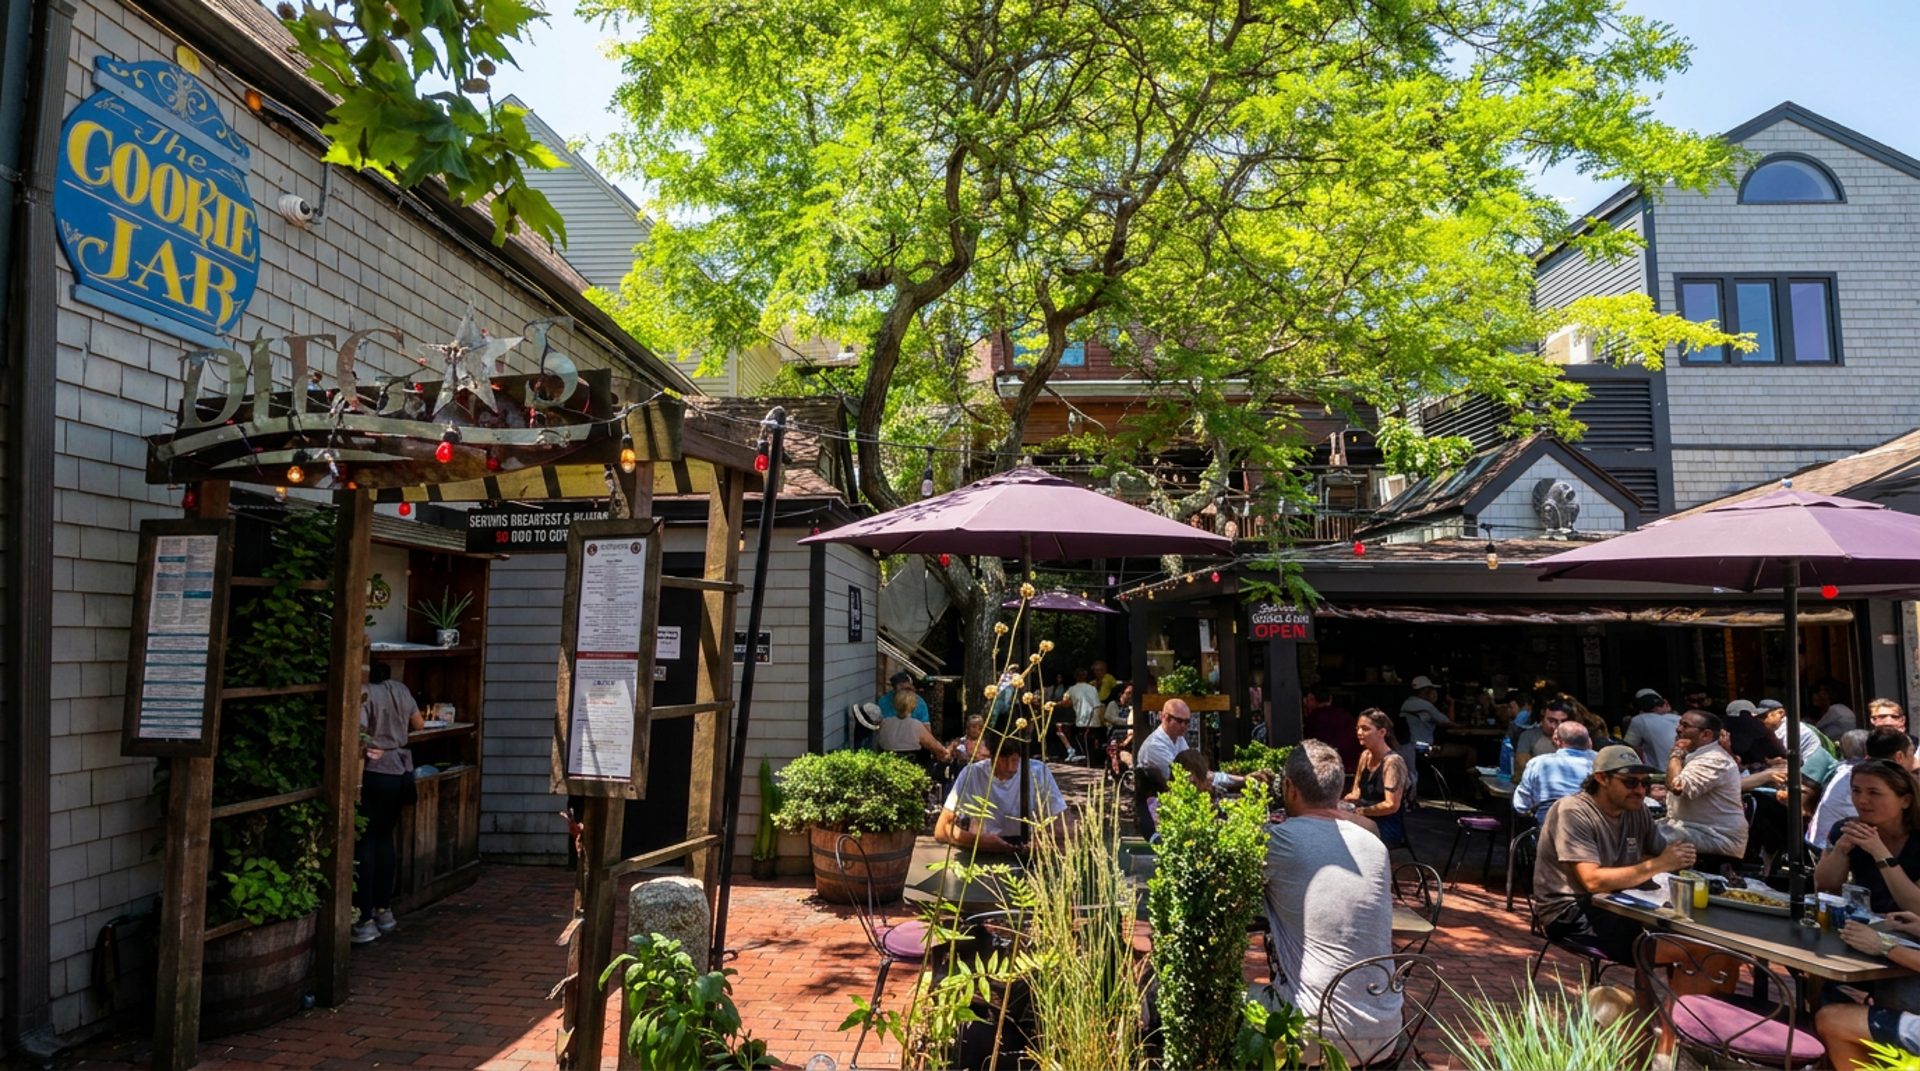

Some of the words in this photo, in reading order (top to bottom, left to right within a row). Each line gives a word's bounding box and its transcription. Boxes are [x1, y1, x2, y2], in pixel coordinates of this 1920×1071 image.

[134, 120, 208, 173] The
[67, 119, 257, 264] COOKIE
[77, 212, 242, 332] JAR
[1255, 624, 1306, 639] OPEN
